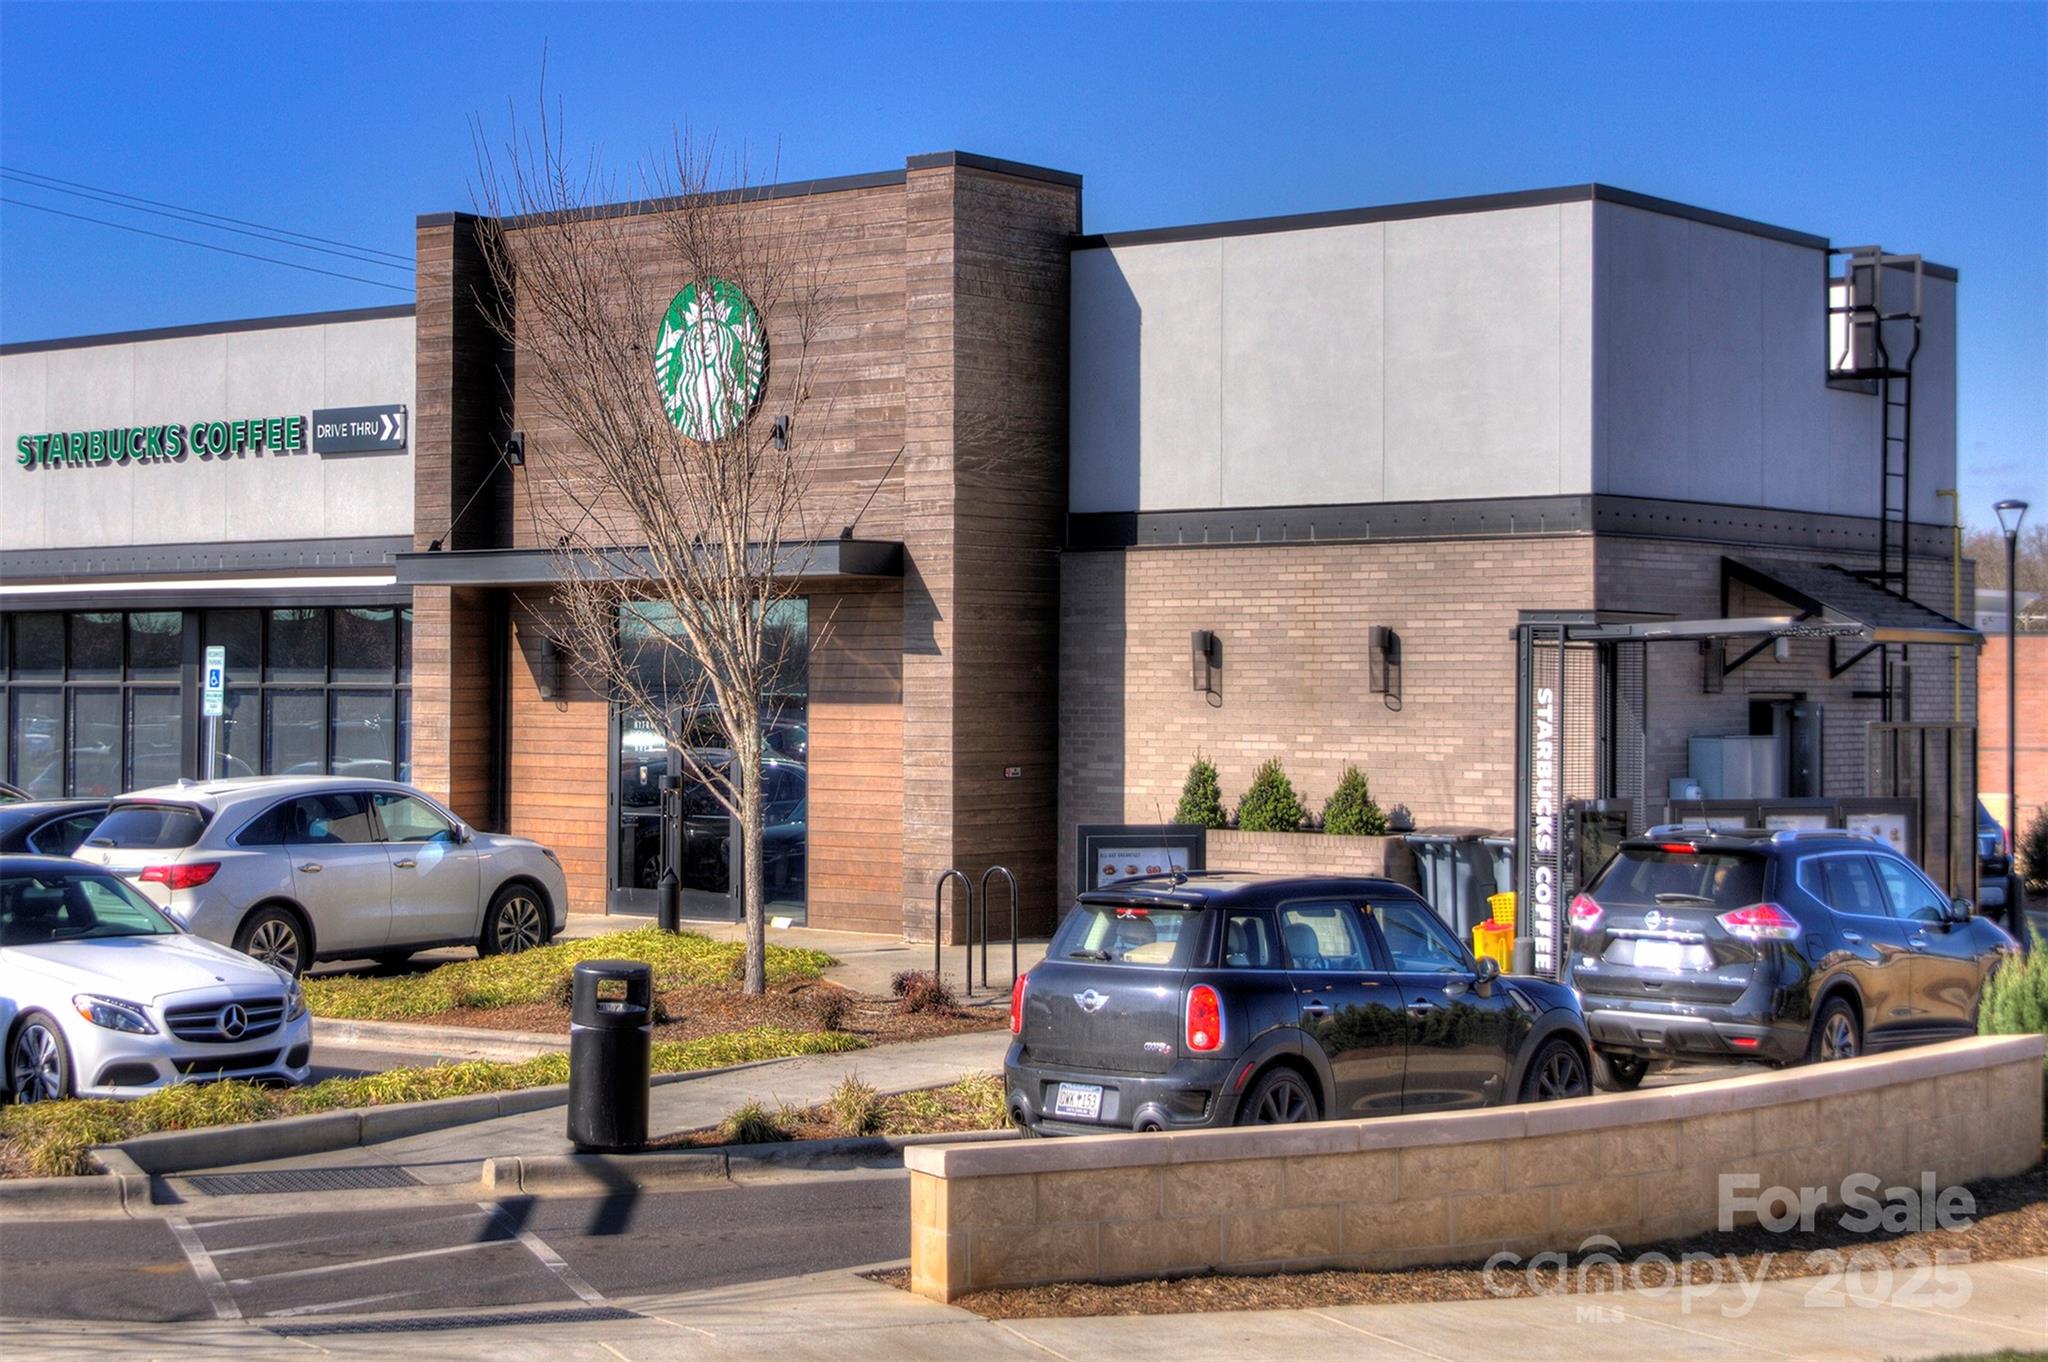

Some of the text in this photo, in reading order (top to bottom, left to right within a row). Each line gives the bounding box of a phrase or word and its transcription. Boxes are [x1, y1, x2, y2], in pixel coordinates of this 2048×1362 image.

[16, 415, 302, 465] STARBUCKS COFFEE
[316, 420, 379, 439] DRIVE THRU
[1534, 687, 1553, 970] STARBUCKS COFFEE
